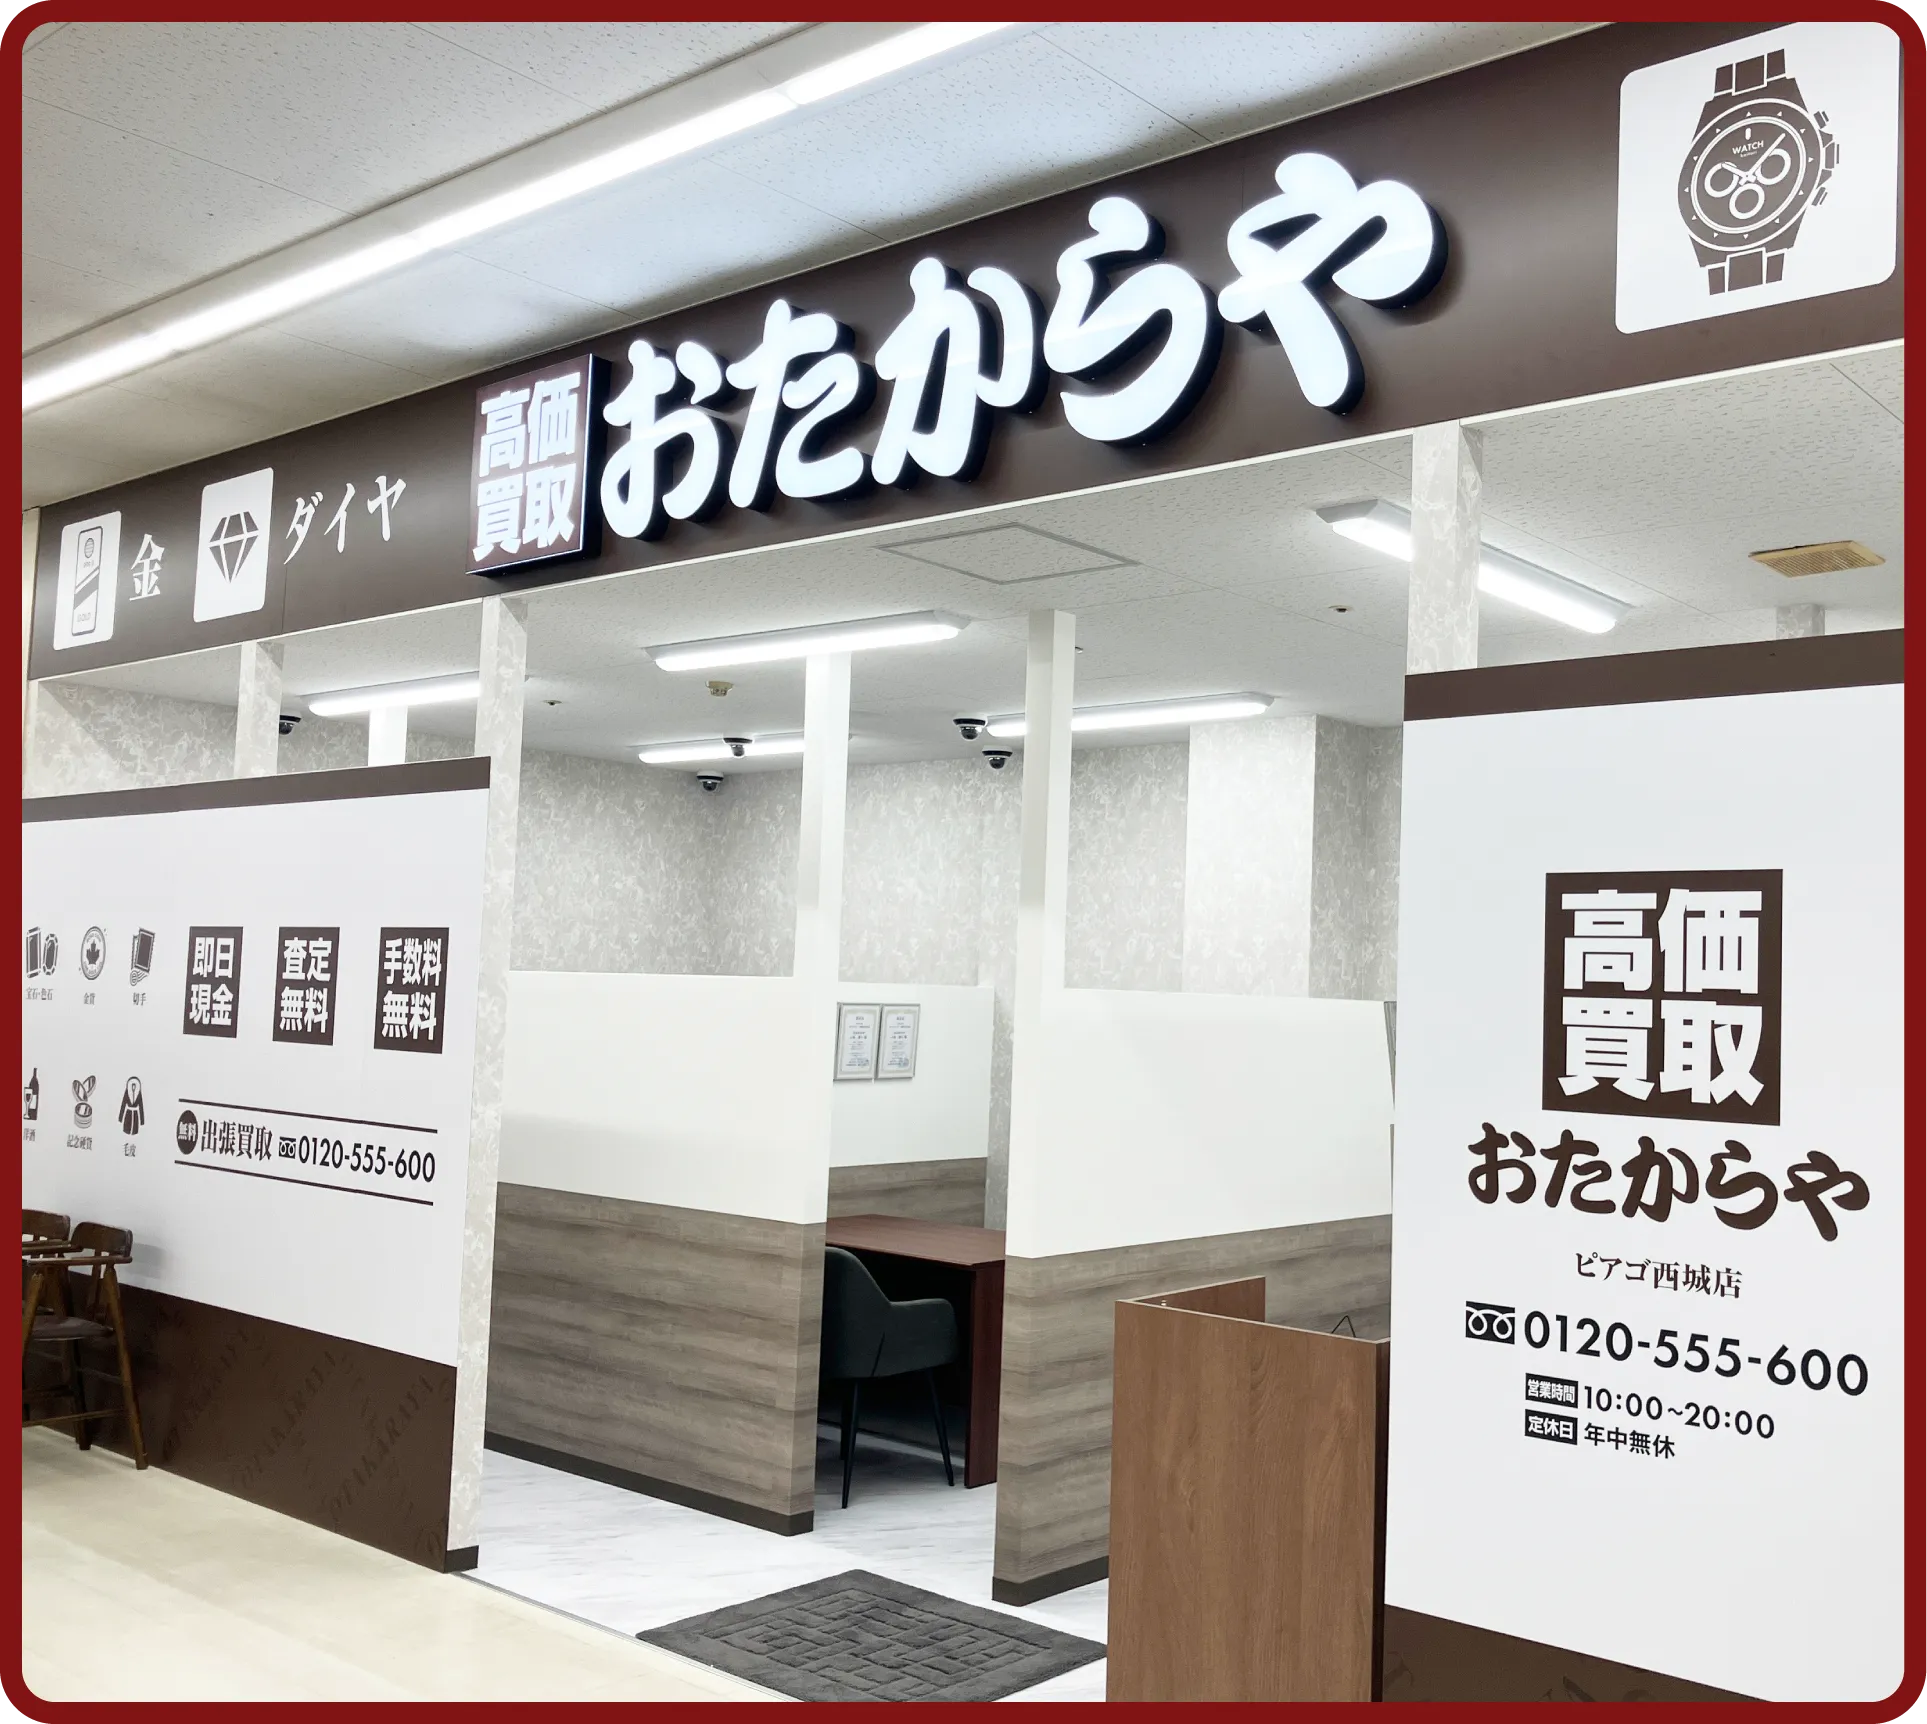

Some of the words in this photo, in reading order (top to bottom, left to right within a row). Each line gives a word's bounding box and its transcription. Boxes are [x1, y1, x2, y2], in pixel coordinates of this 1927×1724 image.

[1732, 140, 1764, 154] WATCH
[600, 152, 1436, 540] おたからや
[480, 371, 581, 477] 高価
[283, 475, 407, 565] ダイヤ
[472, 462, 577, 562] 買取
[129, 533, 165, 601] 金
[193, 937, 235, 978] 即日
[282, 937, 332, 982] 査定
[383, 937, 442, 987] 手数料
[1561, 888, 1763, 994] 高価
[132, 992, 147, 1006] 切手
[189, 983, 234, 1026] 現金
[279, 986, 329, 1033] 無料
[381, 990, 437, 1041] 無料
[1557, 996, 1765, 1106] 買取
[123, 1142, 137, 1157] 毛皮
[178, 1121, 197, 1142] 無料
[201, 1119, 273, 1162] 出張買取
[299, 1135, 436, 1183] 0120-555-600
[1468, 1121, 1871, 1243] おたからや
[1575, 1251, 1743, 1299] ピアゴ西城店
[1524, 1310, 1869, 1397] 0120-555-600
[1527, 1378, 1576, 1404] 営業時間
[1527, 1415, 1574, 1440] 定休日
[1584, 1422, 1676, 1459] 年中無休
